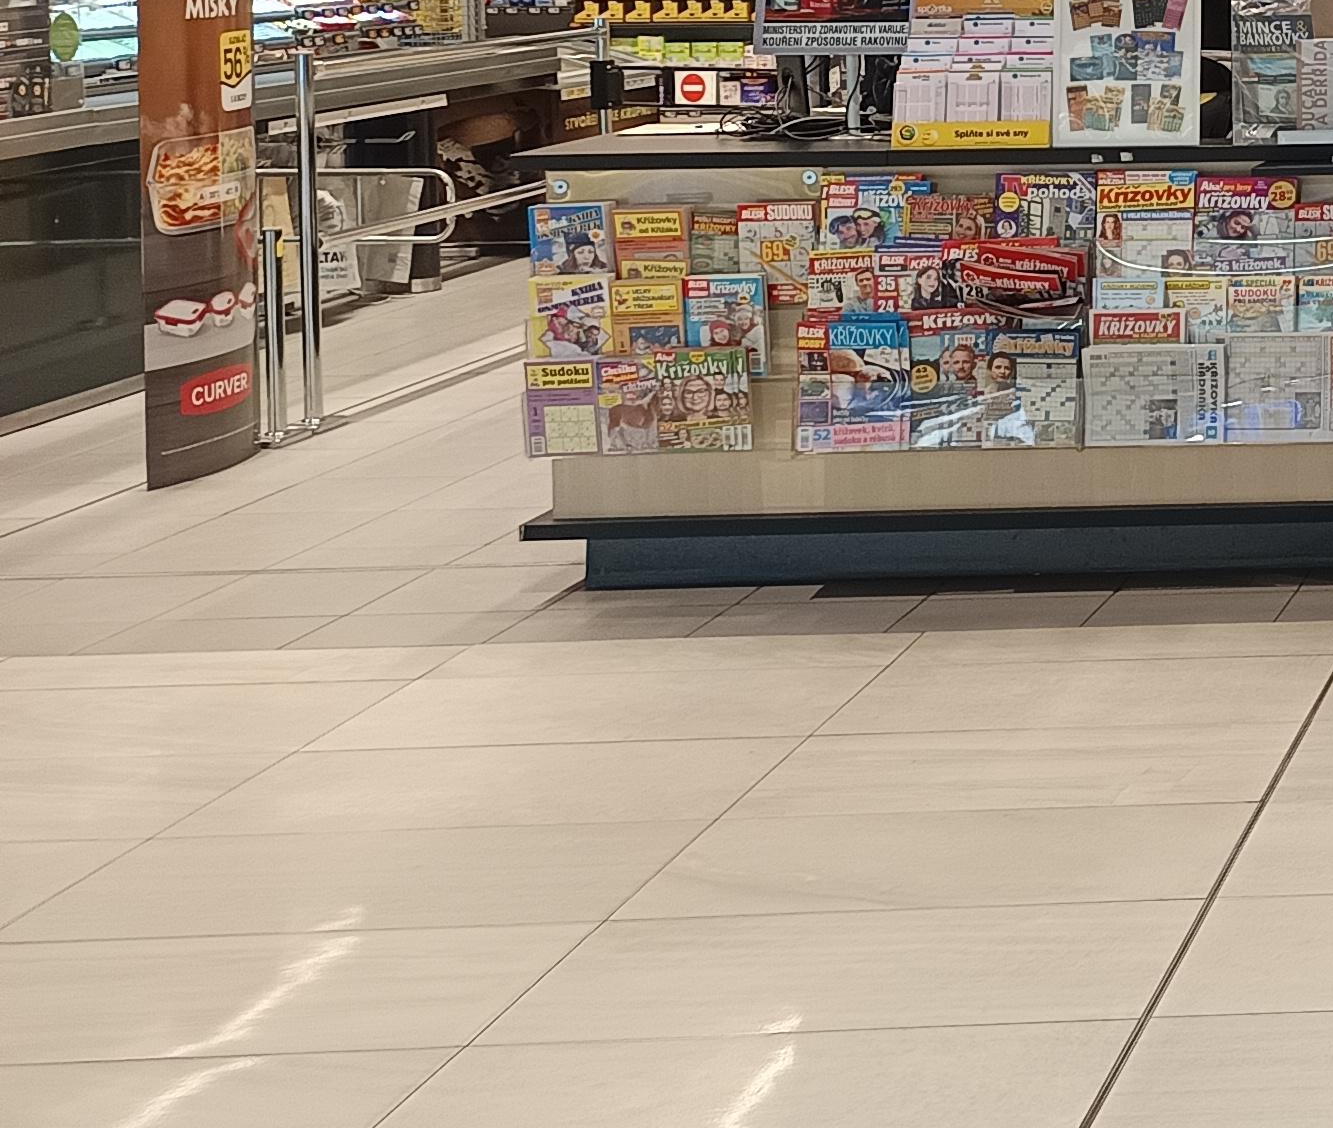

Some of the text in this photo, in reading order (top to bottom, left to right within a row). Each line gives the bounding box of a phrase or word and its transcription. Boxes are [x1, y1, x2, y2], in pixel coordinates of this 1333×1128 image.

[763, 25, 817, 35] MINISTERSTVO
[819, 25, 876, 35] ZDRAVOTNICTVÍ
[1239, 21, 1292, 34] MINCE
[763, 35, 907, 47] KOUŘENÍ ZPŮSOBUJE RAKOVINU
[1314, 40, 1328, 109] DERRIDA
[1021, 174, 1076, 185] KŘÍŽOVKY
[1099, 186, 1192, 205] Křížovky
[1199, 191, 1270, 211] Křížovky
[1271, 190, 1287, 202] 28
[767, 204, 813, 220] SUDOKU
[762, 241, 781, 262] 69
[878, 277, 896, 291] 35
[966, 284, 985, 299] 28
[1233, 289, 1277, 298] SUDOKU
[922, 310, 1007, 331] Křížovky
[1099, 315, 1178, 337] KŘÍŽOVKY
[829, 325, 894, 347] KŘÍŽOVKY
[541, 366, 590, 379] Sudoku
[656, 357, 728, 380] Křížovky
[191, 372, 249, 405] CURVER
[542, 378, 556, 388] pro
[813, 428, 832, 441] 52
